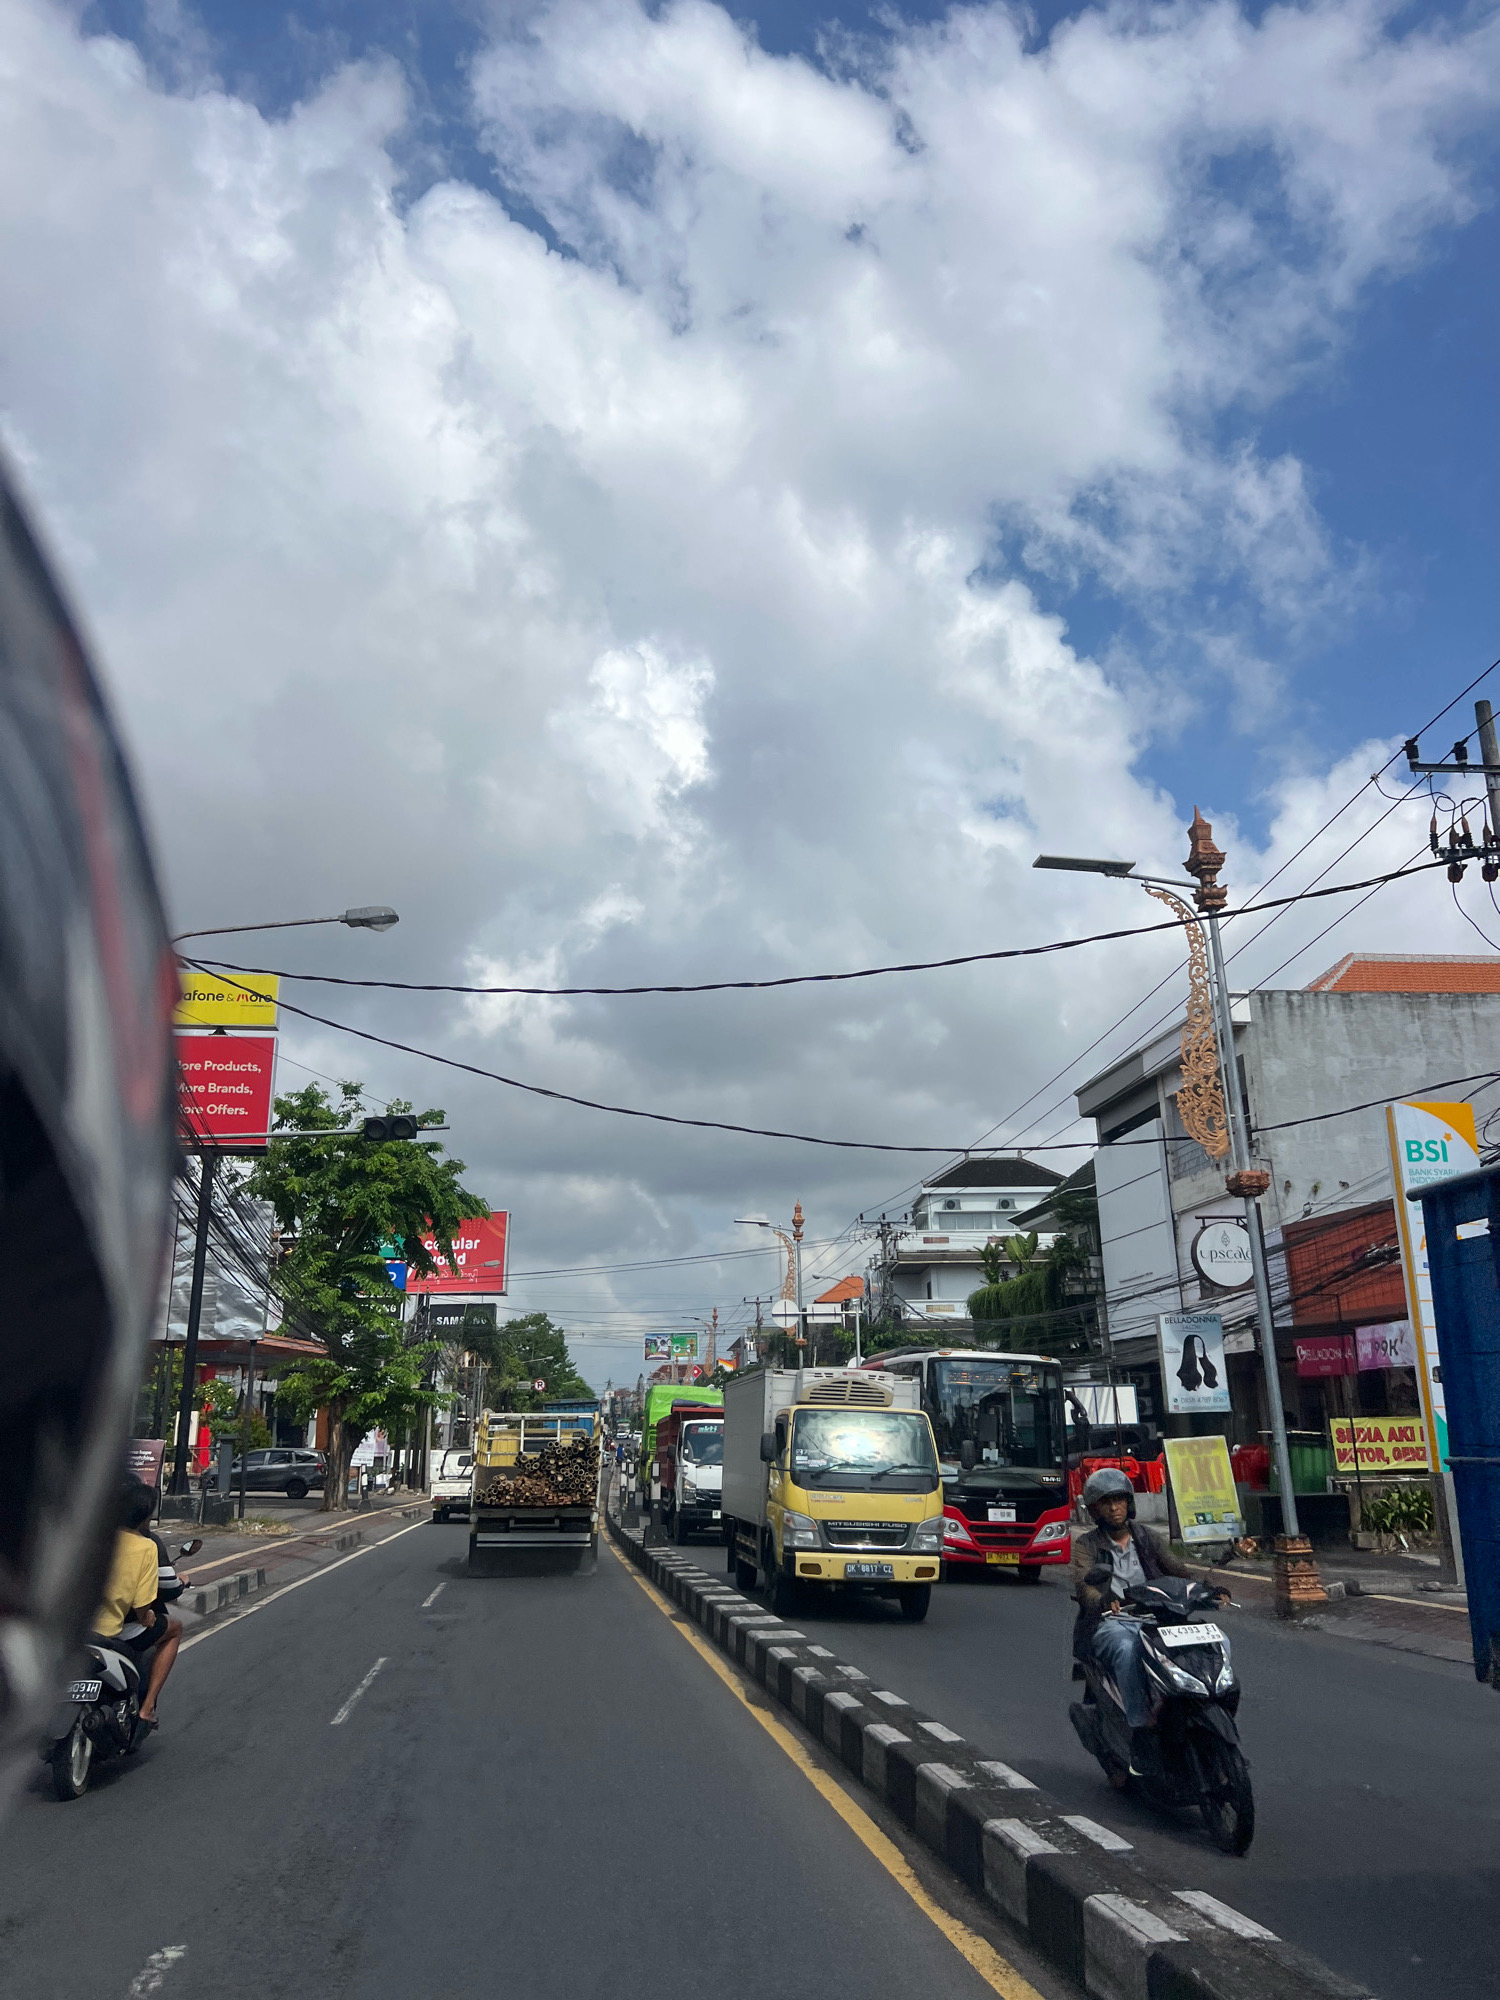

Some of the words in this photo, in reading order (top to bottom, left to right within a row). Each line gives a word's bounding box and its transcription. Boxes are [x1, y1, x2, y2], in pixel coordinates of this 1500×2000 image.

[183, 990, 224, 1002] afone
[226, 993, 234, 1002] &
[204, 1060, 262, 1073] Products,
[207, 1082, 254, 1095] Brands,
[206, 1103, 249, 1115] Offers.
[1405, 1139, 1449, 1162] BSI
[1408, 1168, 1432, 1177] BANK
[1433, 1168, 1464, 1177] SYARIA
[1165, 1316, 1218, 1325] BELLADONNA
[1387, 1426, 1416, 1443] AKI
[1392, 1446, 1427, 1462] GENZ
[1181, 1455, 1227, 1493] AKI
[847, 1564, 857, 1573] DK
